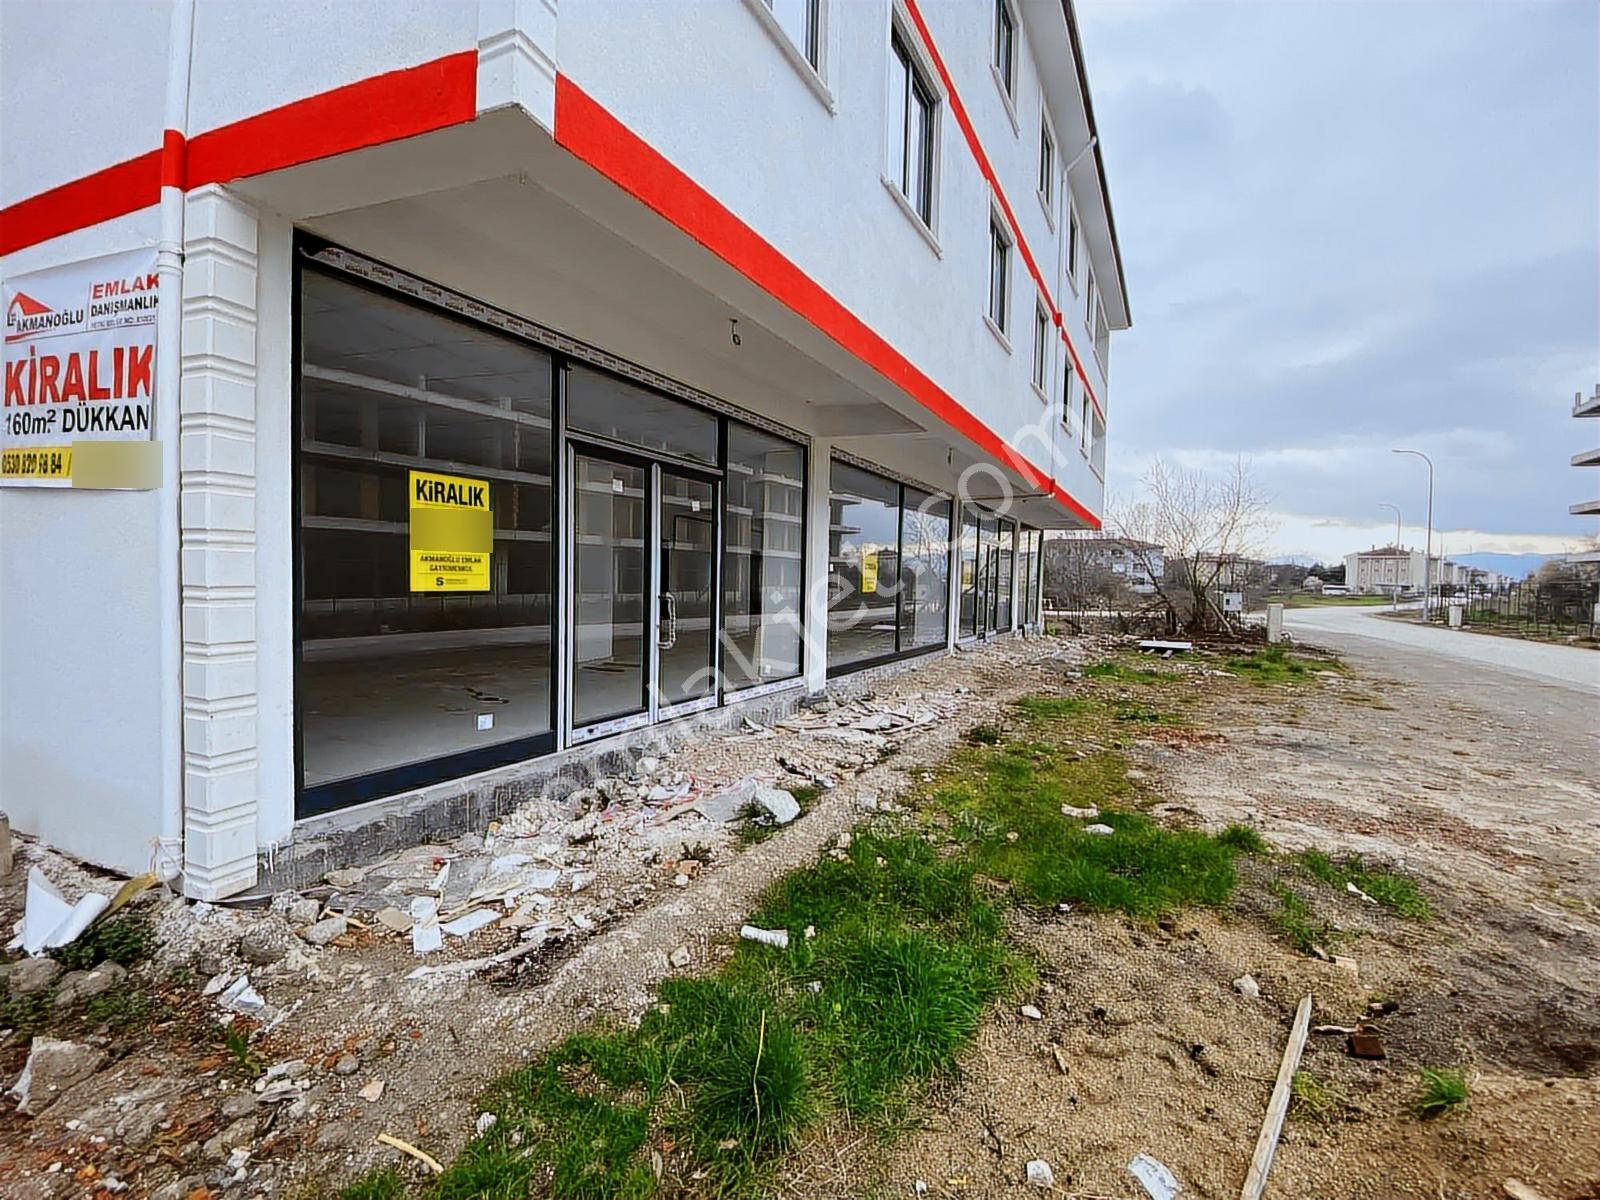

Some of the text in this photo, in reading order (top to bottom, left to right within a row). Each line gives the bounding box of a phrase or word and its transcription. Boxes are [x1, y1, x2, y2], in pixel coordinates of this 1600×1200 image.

[92, 273, 159, 300] EMLAK
[16, 309, 84, 333] AKMANOĞLU
[4, 344, 153, 407] KİRALIK
[62, 402, 150, 432] DÜKKAN
